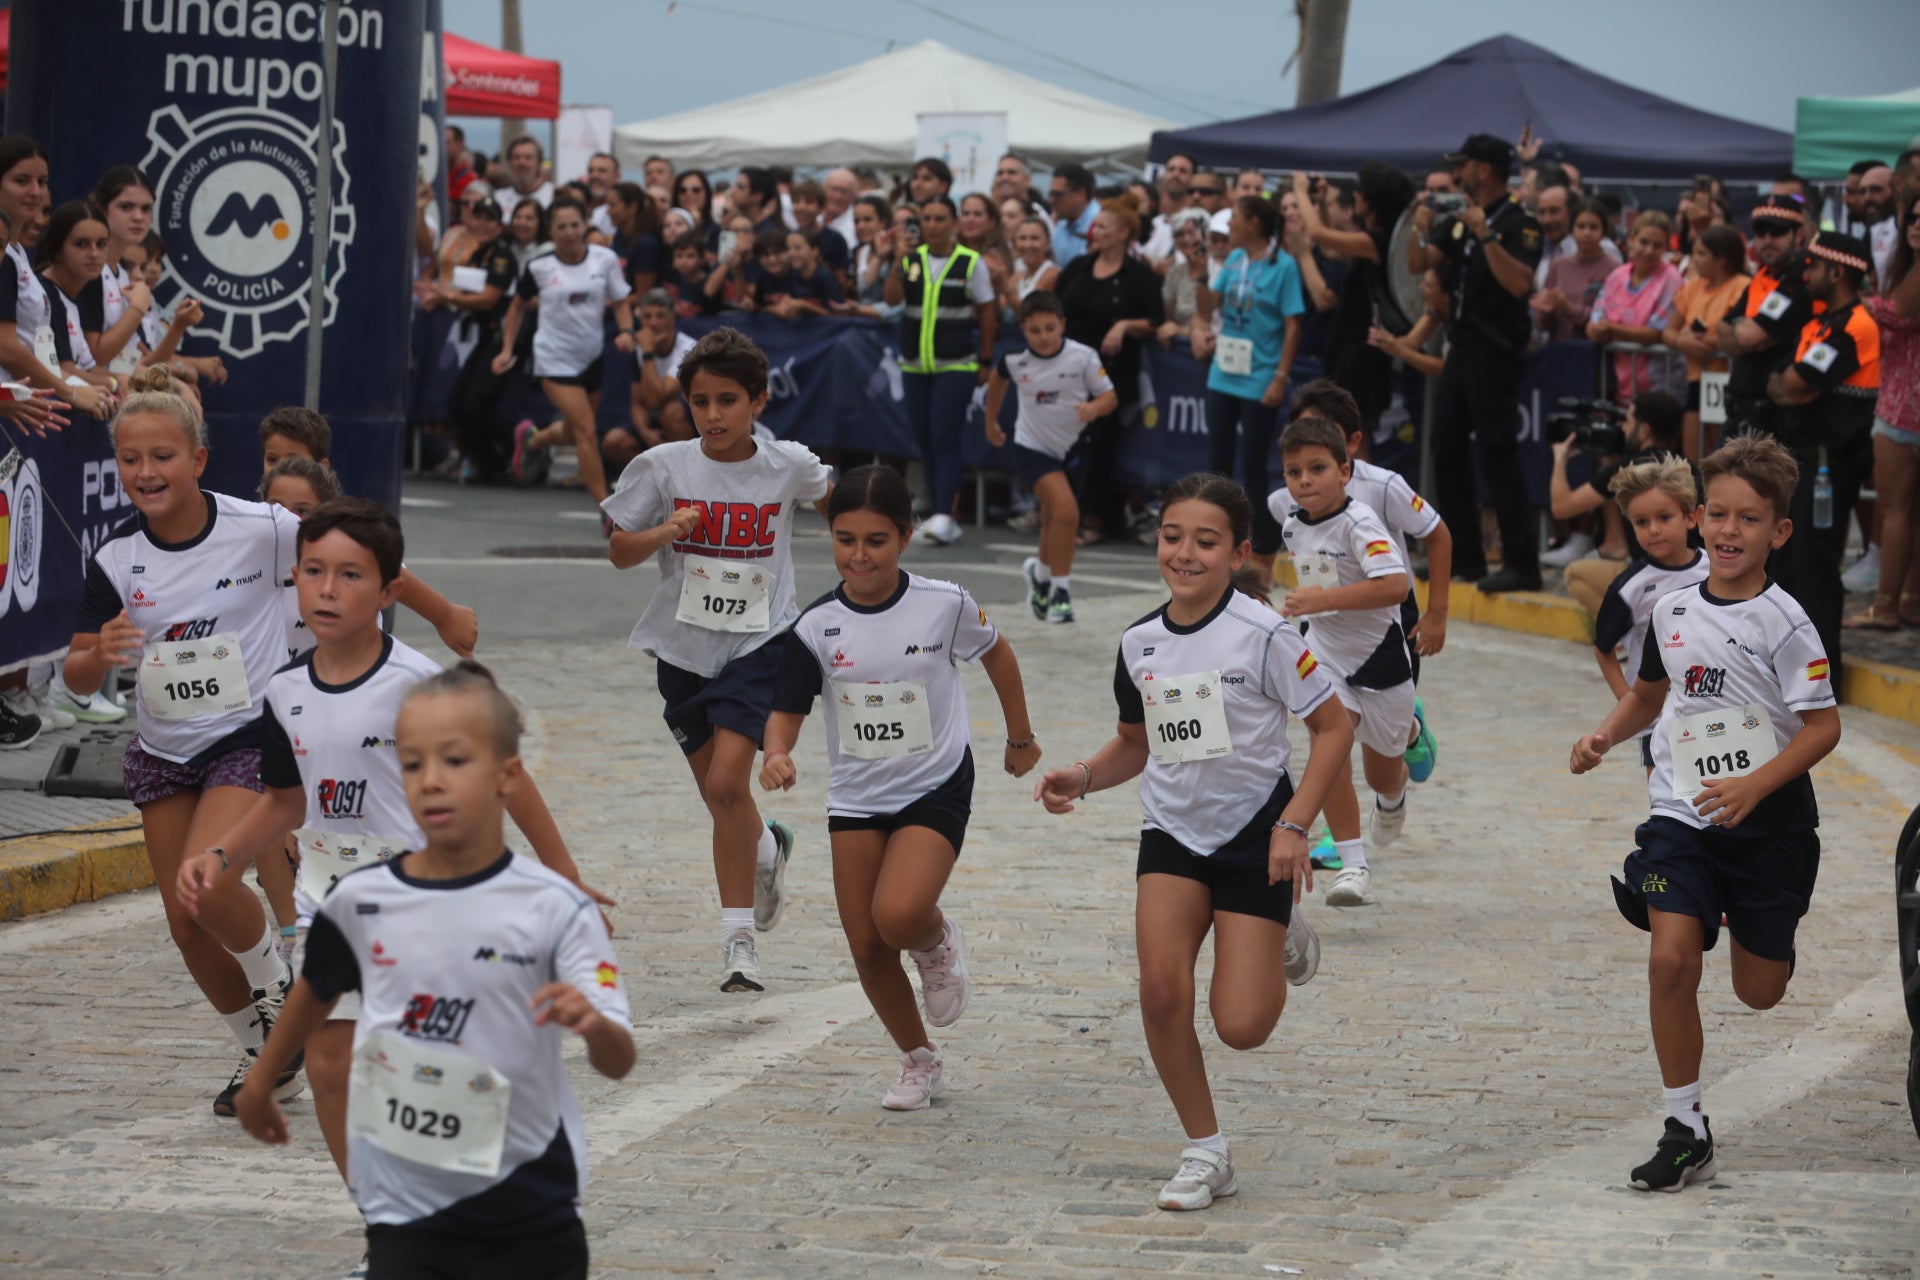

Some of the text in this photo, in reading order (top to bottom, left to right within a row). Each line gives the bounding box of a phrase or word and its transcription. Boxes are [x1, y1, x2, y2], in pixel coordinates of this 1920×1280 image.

[165, 53, 324, 110] mupo
[169, 157, 208, 229] Fundación
[209, 145, 228, 162] de
[231, 139, 246, 153] la
[250, 139, 316, 195] Mutualidad
[203, 273, 284, 300] POLICÍA
[236, 570, 263, 587] mupol
[703, 595, 747, 615] 1073
[922, 641, 943, 654] mupol
[164, 677, 220, 701] 1056
[853, 722, 905, 742] 1025
[1158, 718, 1201, 743] 1060
[1694, 749, 1751, 777] 1018
[386, 1097, 461, 1140] 1029
